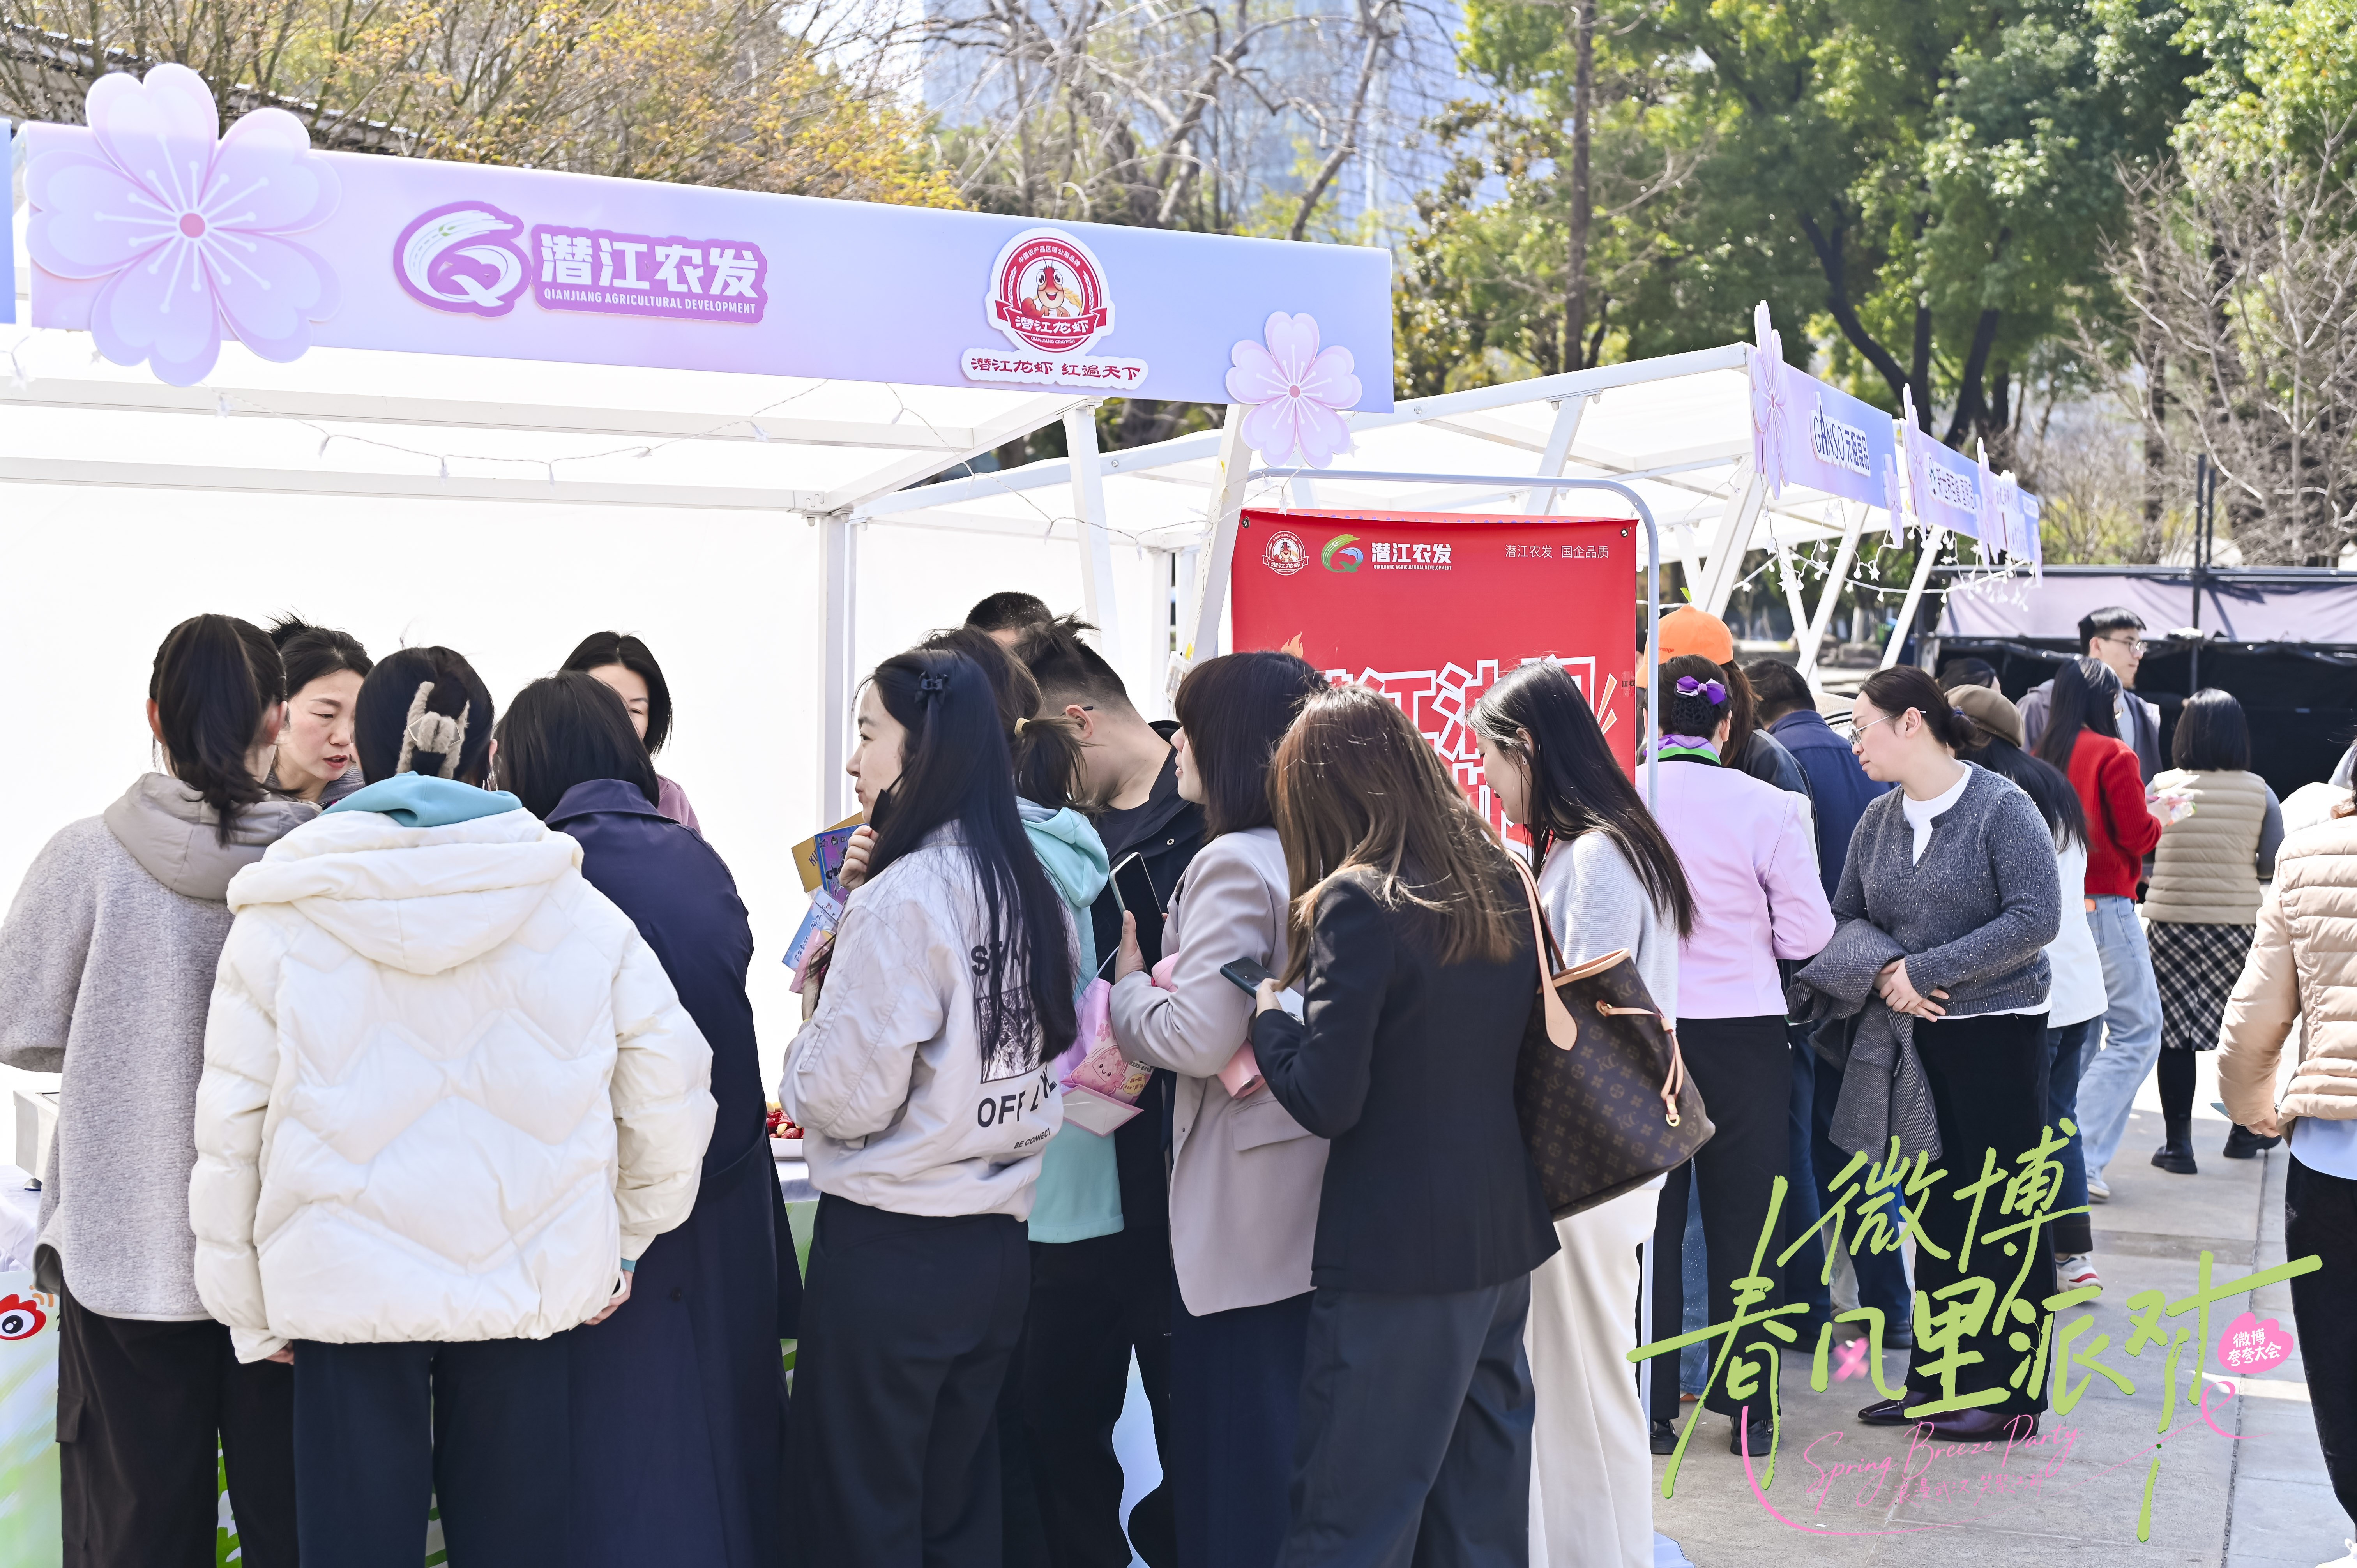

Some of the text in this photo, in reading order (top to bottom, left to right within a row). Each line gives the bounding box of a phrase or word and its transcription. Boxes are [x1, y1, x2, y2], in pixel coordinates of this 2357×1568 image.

[540, 233, 758, 298] 潜江农发
[1018, 245, 1081, 267] 中国农产品区域公用品牌
[544, 288, 755, 314] QIANJIANG AGRICULTURAL DEVELOPMENT
[1014, 316, 1090, 334] 潜江龙虾
[971, 358, 1141, 380] 潜江龙虾 红遍天下
[1814, 399, 1845, 461] GANSO
[1845, 429, 1869, 470] 元祖食品
[1371, 542, 1452, 563] 潜江农发
[1505, 544, 1609, 558] 潜江农发 国企品质
[1014, 1141, 1025, 1149] BE
